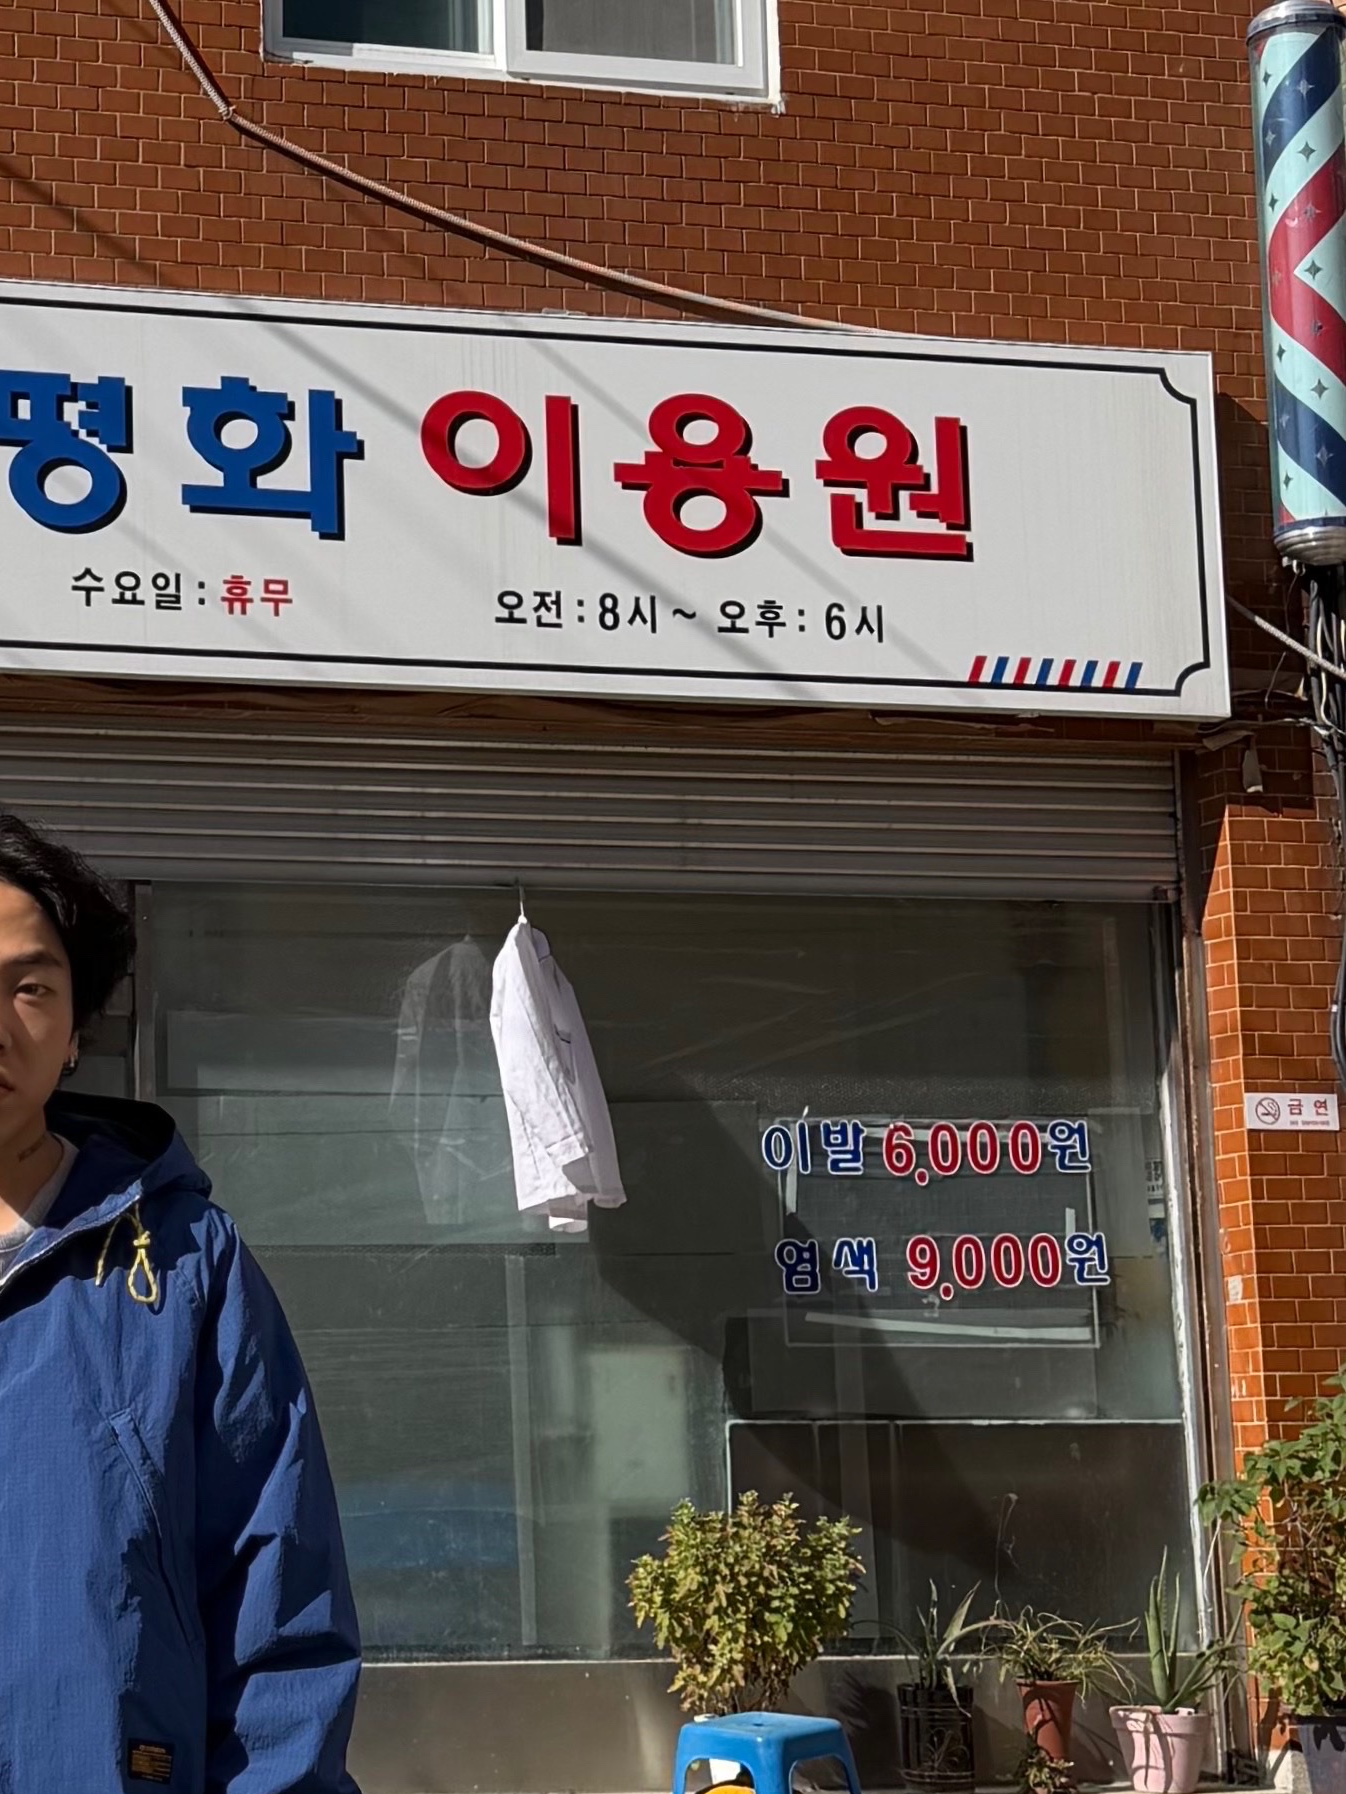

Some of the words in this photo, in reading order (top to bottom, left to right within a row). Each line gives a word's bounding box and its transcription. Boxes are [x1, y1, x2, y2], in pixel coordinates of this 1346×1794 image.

[420, 390, 974, 562] 이용원
[1288, 1098, 1329, 1116] 금연
[762, 1119, 866, 1176] 이발
